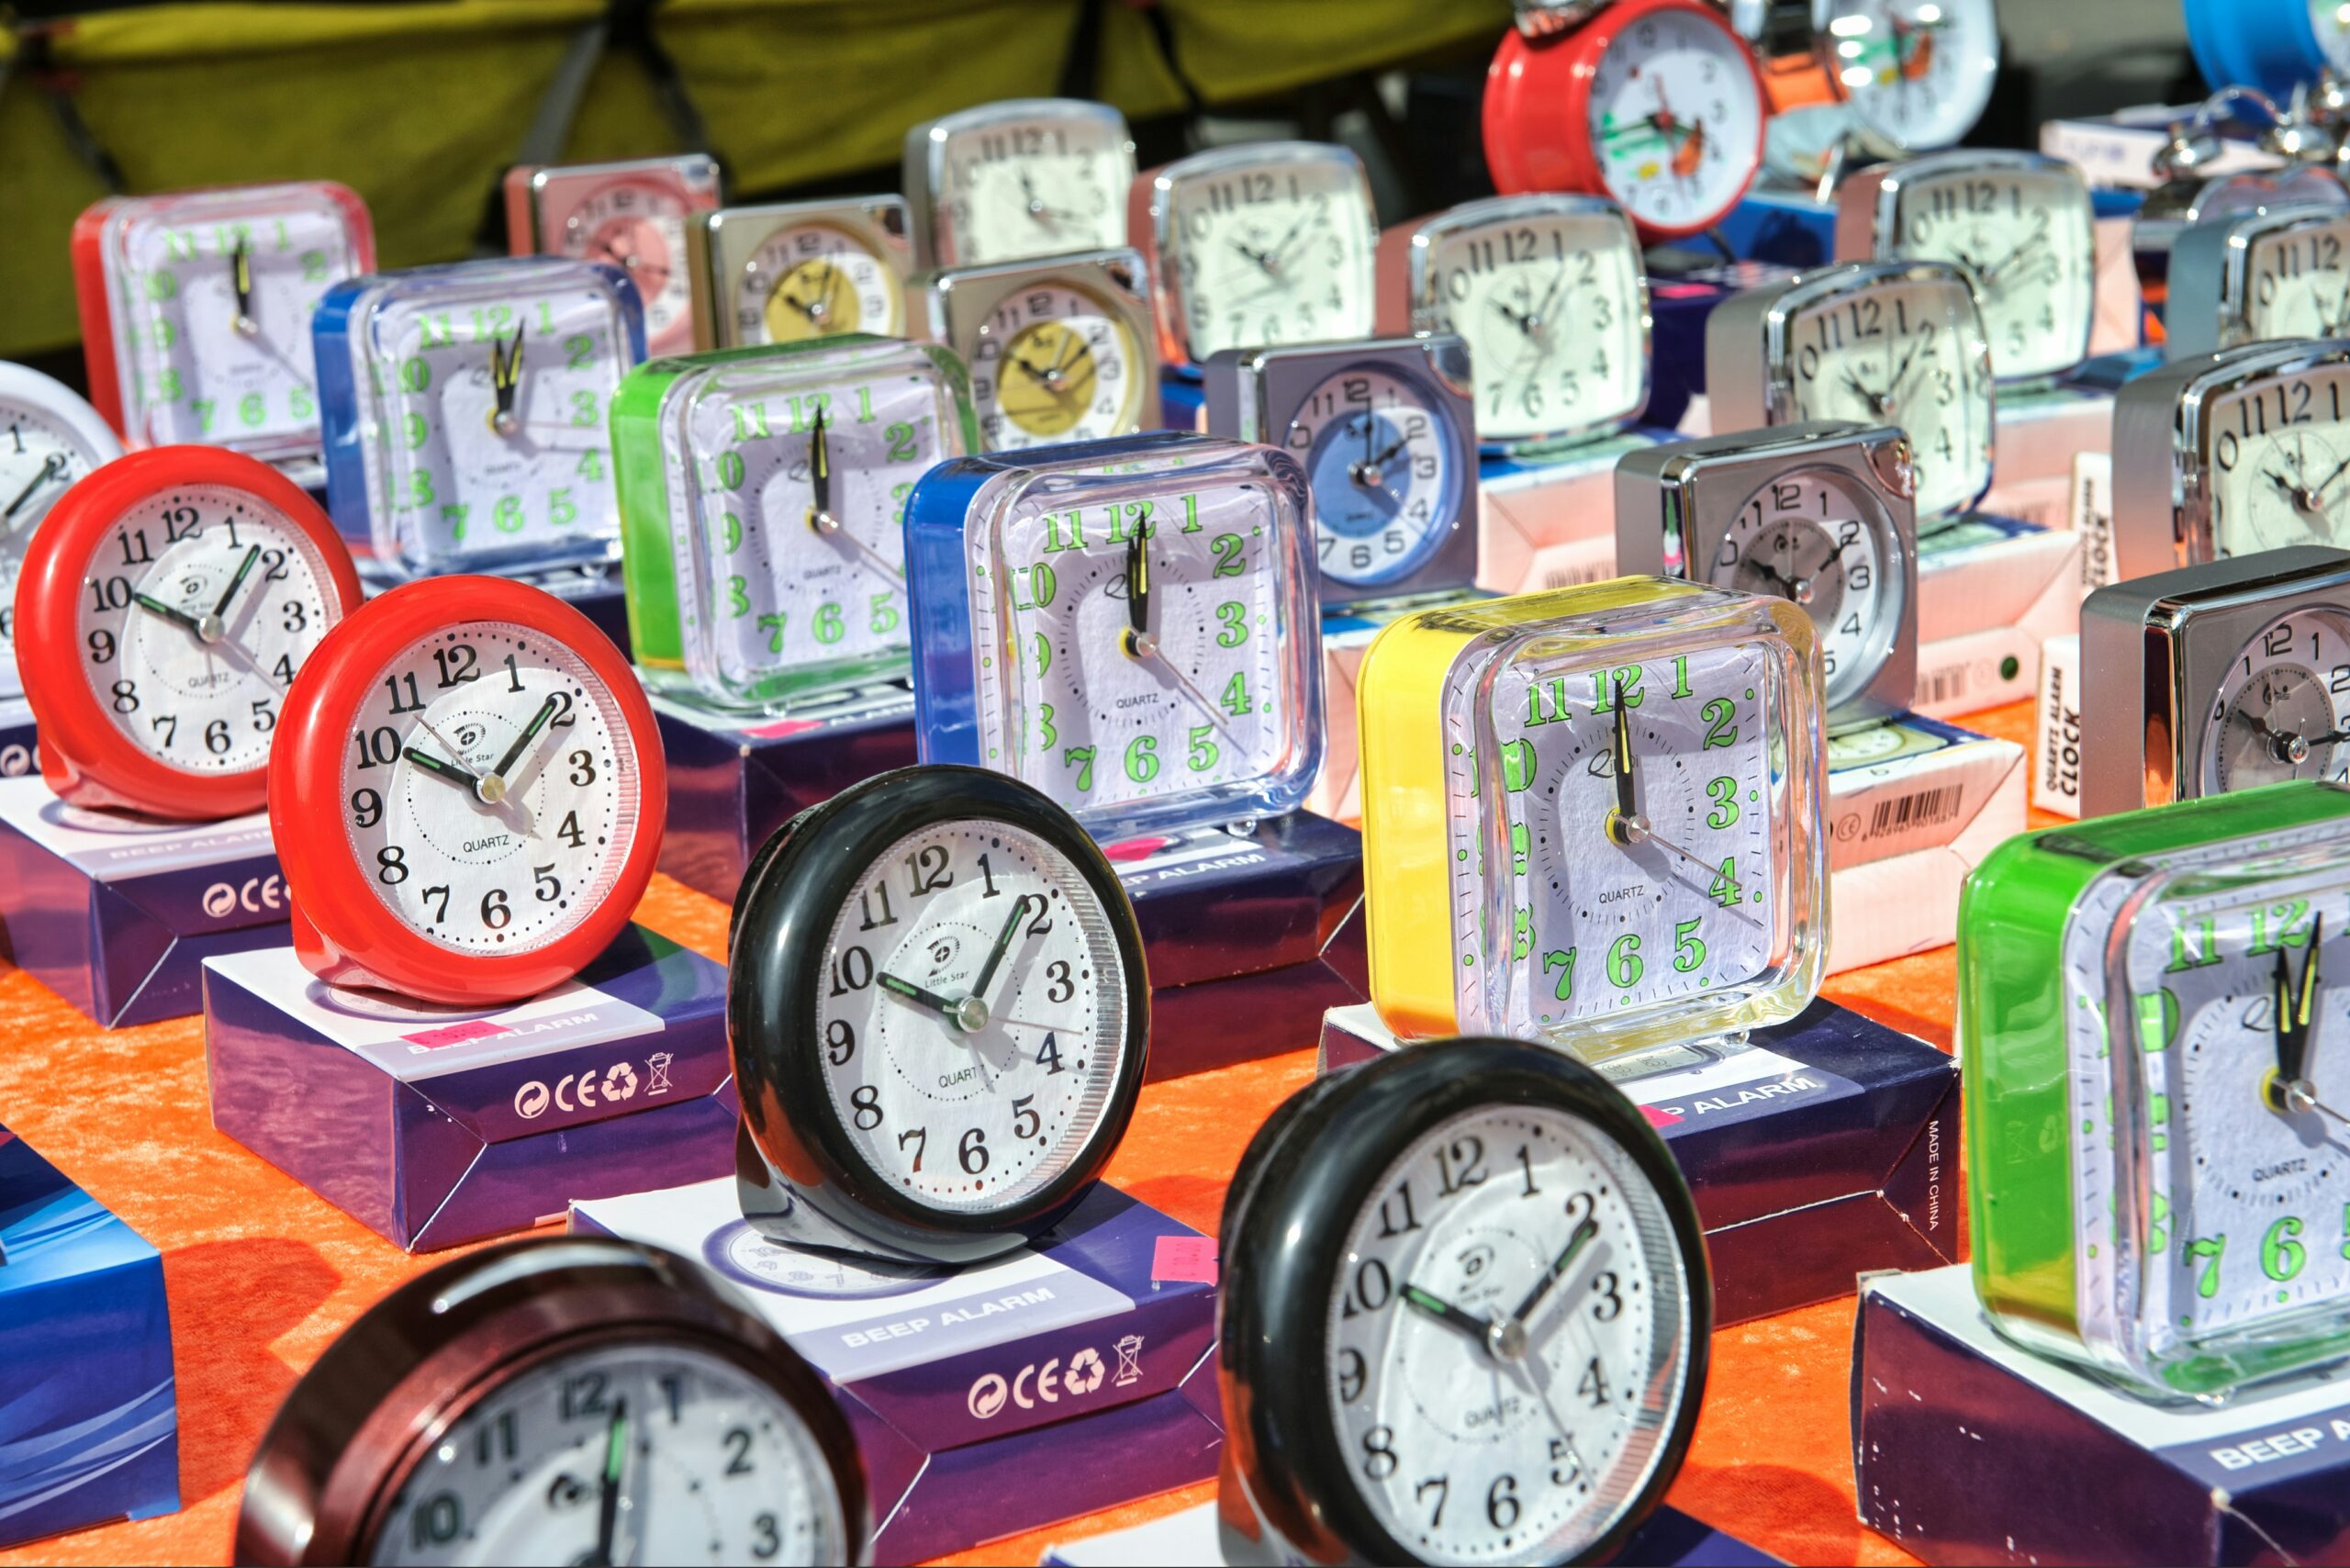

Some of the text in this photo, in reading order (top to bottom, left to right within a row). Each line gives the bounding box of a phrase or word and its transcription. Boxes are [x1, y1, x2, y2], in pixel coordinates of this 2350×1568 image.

[1469, 240, 1494, 274] 11
[1504, 228, 1538, 263] 12
[2277, 243, 2300, 279] 11
[2311, 234, 2342, 271] 12
[418, 313, 454, 350] 11
[471, 305, 514, 343] 12
[536, 300, 554, 335] 1
[1818, 312, 1843, 352] 11
[1850, 298, 1883, 339] 12
[1895, 298, 1908, 335] 1
[564, 335, 594, 370] 2
[1919, 319, 1937, 360] 2
[855, 386, 876, 424] 1
[1313, 393, 1335, 417] 11
[1345, 379, 1371, 403] 12
[1487, 382, 1505, 417] 7
[1935, 367, 1954, 407] 3
[2277, 380, 2311, 426] 12
[2329, 381, 2342, 423] 1
[571, 390, 599, 427] 3
[730, 404, 771, 442] 11
[787, 393, 834, 434] 12
[1407, 416, 1427, 440] 2
[2239, 395, 2267, 438] 11
[884, 421, 919, 463] 2
[1934, 427, 1953, 463] 4
[576, 448, 603, 482] 4
[1414, 455, 1437, 480] 3
[493, 495, 524, 533] 6
[548, 488, 578, 525] 5
[1181, 494, 1203, 533] 1
[1409, 498, 1429, 522] 4
[1739, 499, 1762, 530] 11
[1771, 484, 1801, 511] 12
[1818, 491, 1828, 518] 1
[162, 507, 203, 543] 12
[224, 516, 242, 549] 1
[441, 503, 470, 542] 7
[1043, 510, 1089, 554] 11
[1104, 500, 1157, 544] 12
[1383, 530, 1405, 554] 5
[1840, 521, 1861, 545] 2
[118, 529, 154, 566] 11
[261, 549, 288, 583] 2
[1211, 533, 1247, 579] 2
[1317, 538, 1337, 562] 7
[1350, 544, 1372, 569] 6
[90, 576, 133, 612] 10
[1850, 566, 1872, 591] 3
[282, 600, 307, 633] 3
[757, 610, 788, 654] 7
[811, 602, 845, 644] 6
[869, 591, 899, 633] 5
[1216, 601, 1248, 648] 3
[1841, 612, 1863, 636] 4
[88, 629, 117, 664] 9
[2263, 622, 2293, 658] 12
[2311, 632, 2321, 661] 1
[273, 653, 295, 687] 4
[433, 644, 481, 689] 12
[504, 654, 525, 693] 1
[1671, 655, 1694, 700] 1
[111, 679, 140, 714] 8
[385, 671, 427, 714] 11
[1116, 693, 1158, 709] QUARTZ
[1220, 672, 1252, 717] 4
[1524, 678, 1572, 728] 11
[1590, 664, 1645, 716] 12
[152, 714, 176, 747] 7
[252, 699, 275, 732] 5
[546, 691, 576, 730] 2
[1701, 698, 1738, 750] 2
[205, 720, 231, 755] 6
[354, 726, 402, 769] 10
[1188, 722, 1219, 771] 5
[2061, 707, 2079, 796] CLOCK
[569, 749, 596, 787] 3
[1065, 745, 1097, 792] 7
[1124, 735, 1160, 782] 6
[352, 788, 383, 828] 9
[1706, 776, 1740, 830] 3
[463, 834, 509, 853] QUARTZ
[557, 810, 586, 848] 4
[377, 846, 408, 885] 8
[533, 863, 561, 902] 5
[905, 845, 954, 898] 12
[977, 853, 1001, 899] 1
[1158, 854, 1266, 879] ALARM
[1708, 857, 1742, 909] 4
[422, 884, 450, 924] 7
[481, 889, 511, 929] 6
[859, 879, 898, 932] 11
[1598, 885, 1644, 904] QUARTZ
[1023, 893, 1052, 939] 2
[2246, 900, 2311, 958] 12
[1673, 915, 1707, 973] 5
[2165, 907, 2223, 974] 11
[830, 946, 874, 997] 10
[924, 970, 969, 989] Little Star
[1046, 960, 1075, 1003] 3
[1543, 946, 1577, 1002] 7
[1606, 934, 1644, 989] 6
[496, 1014, 599, 1040] ALARM
[826, 1019, 856, 1066] 9
[1035, 1031, 1065, 1076] 4
[850, 1085, 883, 1130] 8
[1694, 1077, 1818, 1114] ALARM
[1012, 1093, 1041, 1139] 5
[899, 1126, 926, 1173] 7
[958, 1128, 990, 1174] 6
[1433, 1136, 1489, 1198] 12
[1515, 1145, 1539, 1197] 1
[1929, 1121, 1940, 1231] MADE IN CHINA
[2253, 1159, 2308, 1182] QUARTZ
[1377, 1181, 1422, 1240] 11
[2184, 1233, 2226, 1299] 7
[2259, 1216, 2307, 1282] 6
[1342, 1259, 1392, 1319] 10
[1592, 1271, 1622, 1322] 3
[841, 1288, 1057, 1348] BEEP ALARM
[559, 1372, 607, 1421] 12
[1338, 1348, 1368, 1405] 9
[1577, 1357, 1609, 1409] 4
[477, 1411, 518, 1464] 11
[724, 1428, 754, 1476] 2
[1363, 1426, 1397, 1482] 8
[2209, 1428, 2324, 1471] BEEP
[1549, 1434, 1579, 1486] 5
[412, 1489, 461, 1552] 10
[1416, 1474, 1449, 1528] 7
[1486, 1475, 1521, 1530] 6
[752, 1513, 780, 1559] 3
